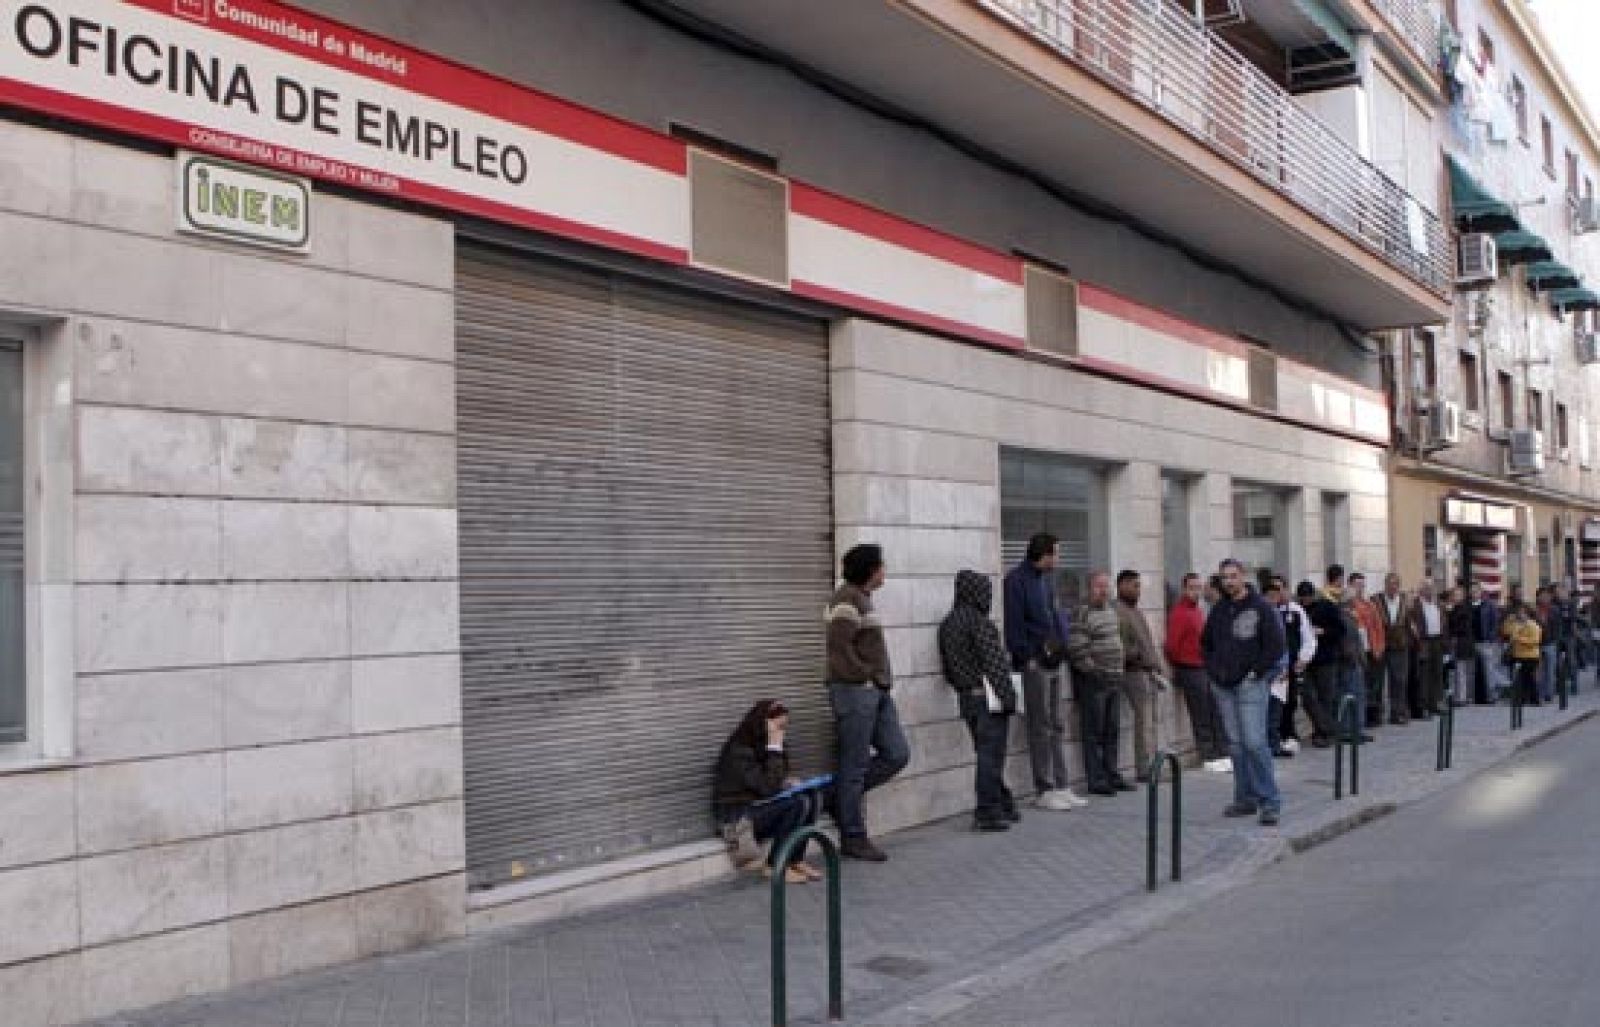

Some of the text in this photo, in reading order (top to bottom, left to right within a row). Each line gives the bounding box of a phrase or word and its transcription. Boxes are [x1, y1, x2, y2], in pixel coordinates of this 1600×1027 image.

[214, 0, 407, 75] Comunidad de Madrid
[14, 5, 529, 185] OFICINA DE EMPLEO
[275, 147, 295, 166] DE
[297, 151, 346, 180] EMPLEO
[359, 169, 400, 192] MUJER
